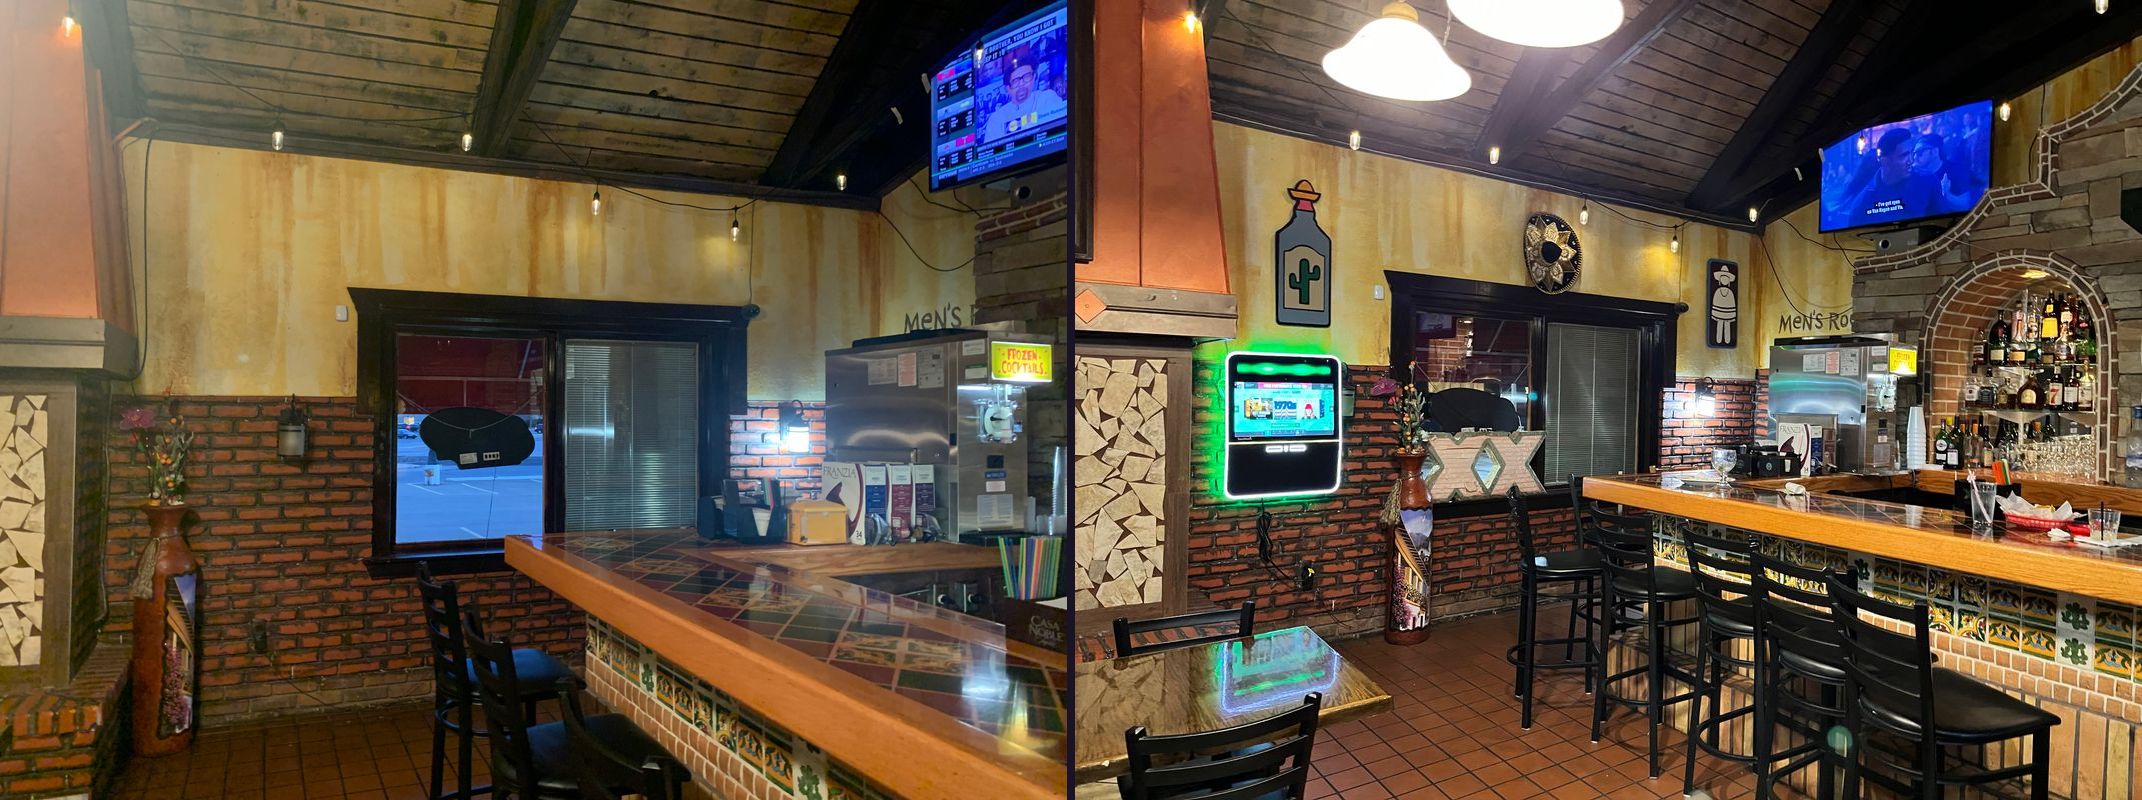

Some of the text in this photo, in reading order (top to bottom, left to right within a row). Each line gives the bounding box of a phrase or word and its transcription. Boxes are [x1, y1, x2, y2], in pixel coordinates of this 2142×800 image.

[1013, 32, 1024, 42] YOU
[1024, 25, 1040, 37] KNOW
[1043, 19, 1054, 29] GOT
[1007, 348, 1038, 360] FROZEN
[2050, 388, 2060, 404] 7
[1273, 401, 1297, 410] 1970s
[822, 465, 857, 480] FRANZIA
[1030, 615, 1061, 632] CASA
